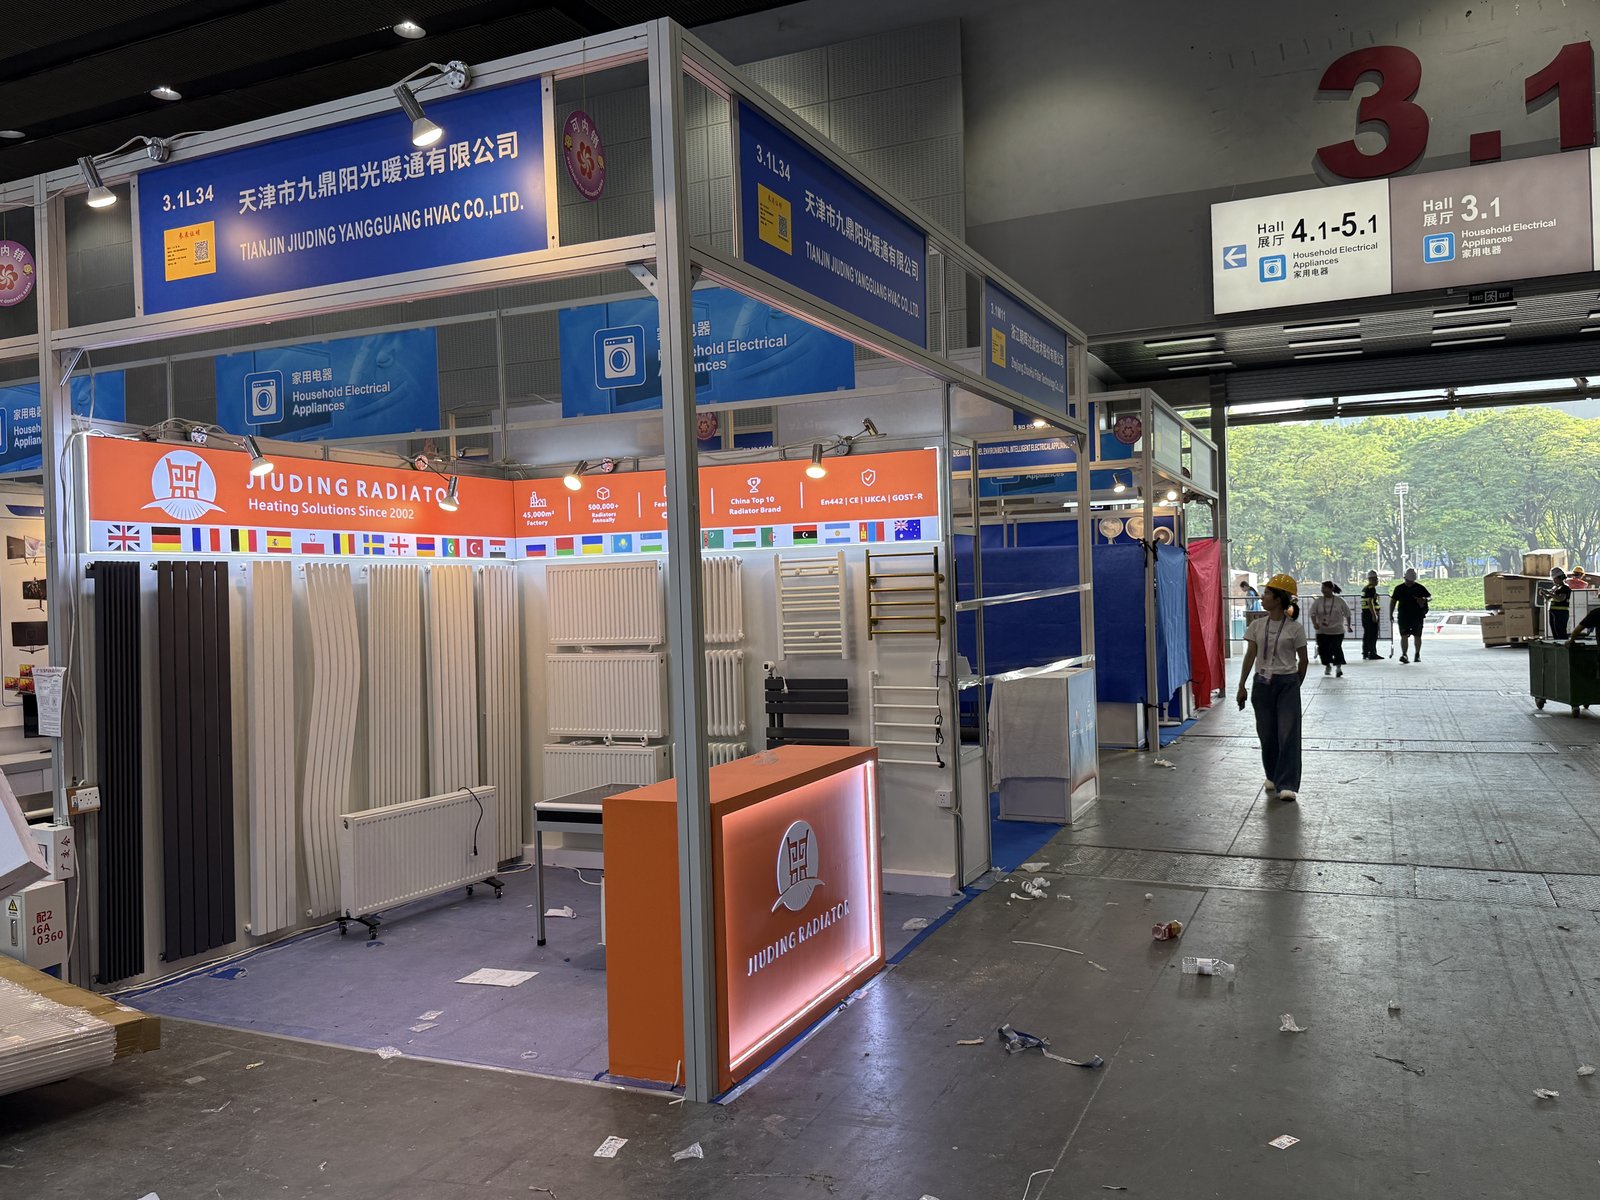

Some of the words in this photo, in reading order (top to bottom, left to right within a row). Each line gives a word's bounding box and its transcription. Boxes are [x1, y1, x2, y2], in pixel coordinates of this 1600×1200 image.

[1317, 40, 1594, 179] 3.1
[757, 144, 790, 182] 3.1L34
[239, 131, 518, 214] 天津市九鼎阳光暖通有限公司
[163, 185, 214, 211] 3.1L34
[1423, 197, 1453, 212] Hall
[1461, 194, 1500, 222] 3.1
[240, 236, 285, 261] TIANJIN
[287, 226, 336, 253] JIUDING
[338, 210, 421, 243] YANGGUANG
[424, 202, 460, 228] HVAC
[464, 191, 524, 219] CO.,LTD.
[1423, 210, 1454, 227] 展厅
[805, 190, 919, 281] 天津市九鼎阳光暖通有限公司
[1257, 221, 1284, 234] Hall
[1291, 212, 1377, 243] 4.1-5.1
[1461, 224, 1511, 238] Household
[1513, 218, 1557, 232] Electrical
[1257, 234, 1285, 248] 展厅
[1461, 235, 1513, 249] Appliances
[1293, 246, 1338, 259] Household
[1339, 242, 1378, 254] Electrical
[1461, 246, 1502, 259] 家用电器
[1293, 257, 1339, 269] Appliances
[805, 241, 830, 269] TIANJIN
[830, 256, 854, 282] JIUDING
[854, 268, 887, 300] YANGGUANG
[887, 287, 900, 308] HVAC
[1293, 267, 1329, 279] 家用电器
[727, 333, 787, 353] Electrical
[291, 368, 332, 385] 家用电器
[292, 386, 343, 402] Household
[345, 381, 391, 396] Electrical
[292, 402, 345, 417] Appliances
[13, 425, 42, 436] Househ
[13, 437, 42, 449] Applian
[246, 472, 348, 497] JIUDING
[588, 503, 620, 511] 500,000+
[730, 497, 750, 505] China
[751, 496, 763, 505] Top
[820, 498, 844, 506] En442
[864, 495, 887, 503] UKCA
[892, 493, 924, 502] GOST-R
[248, 498, 299, 516] Heating
[302, 502, 356, 517] Solutions
[359, 505, 388, 518] Since
[389, 508, 415, 520] 2002
[729, 507, 759, 515] Radiator
[760, 506, 782, 514] Brand
[36, 910, 53, 925] 配2
[32, 922, 51, 936] 16A
[37, 930, 64, 946] 0360
[747, 931, 796, 977] JIUDING
[798, 899, 850, 944] RADIATOR
